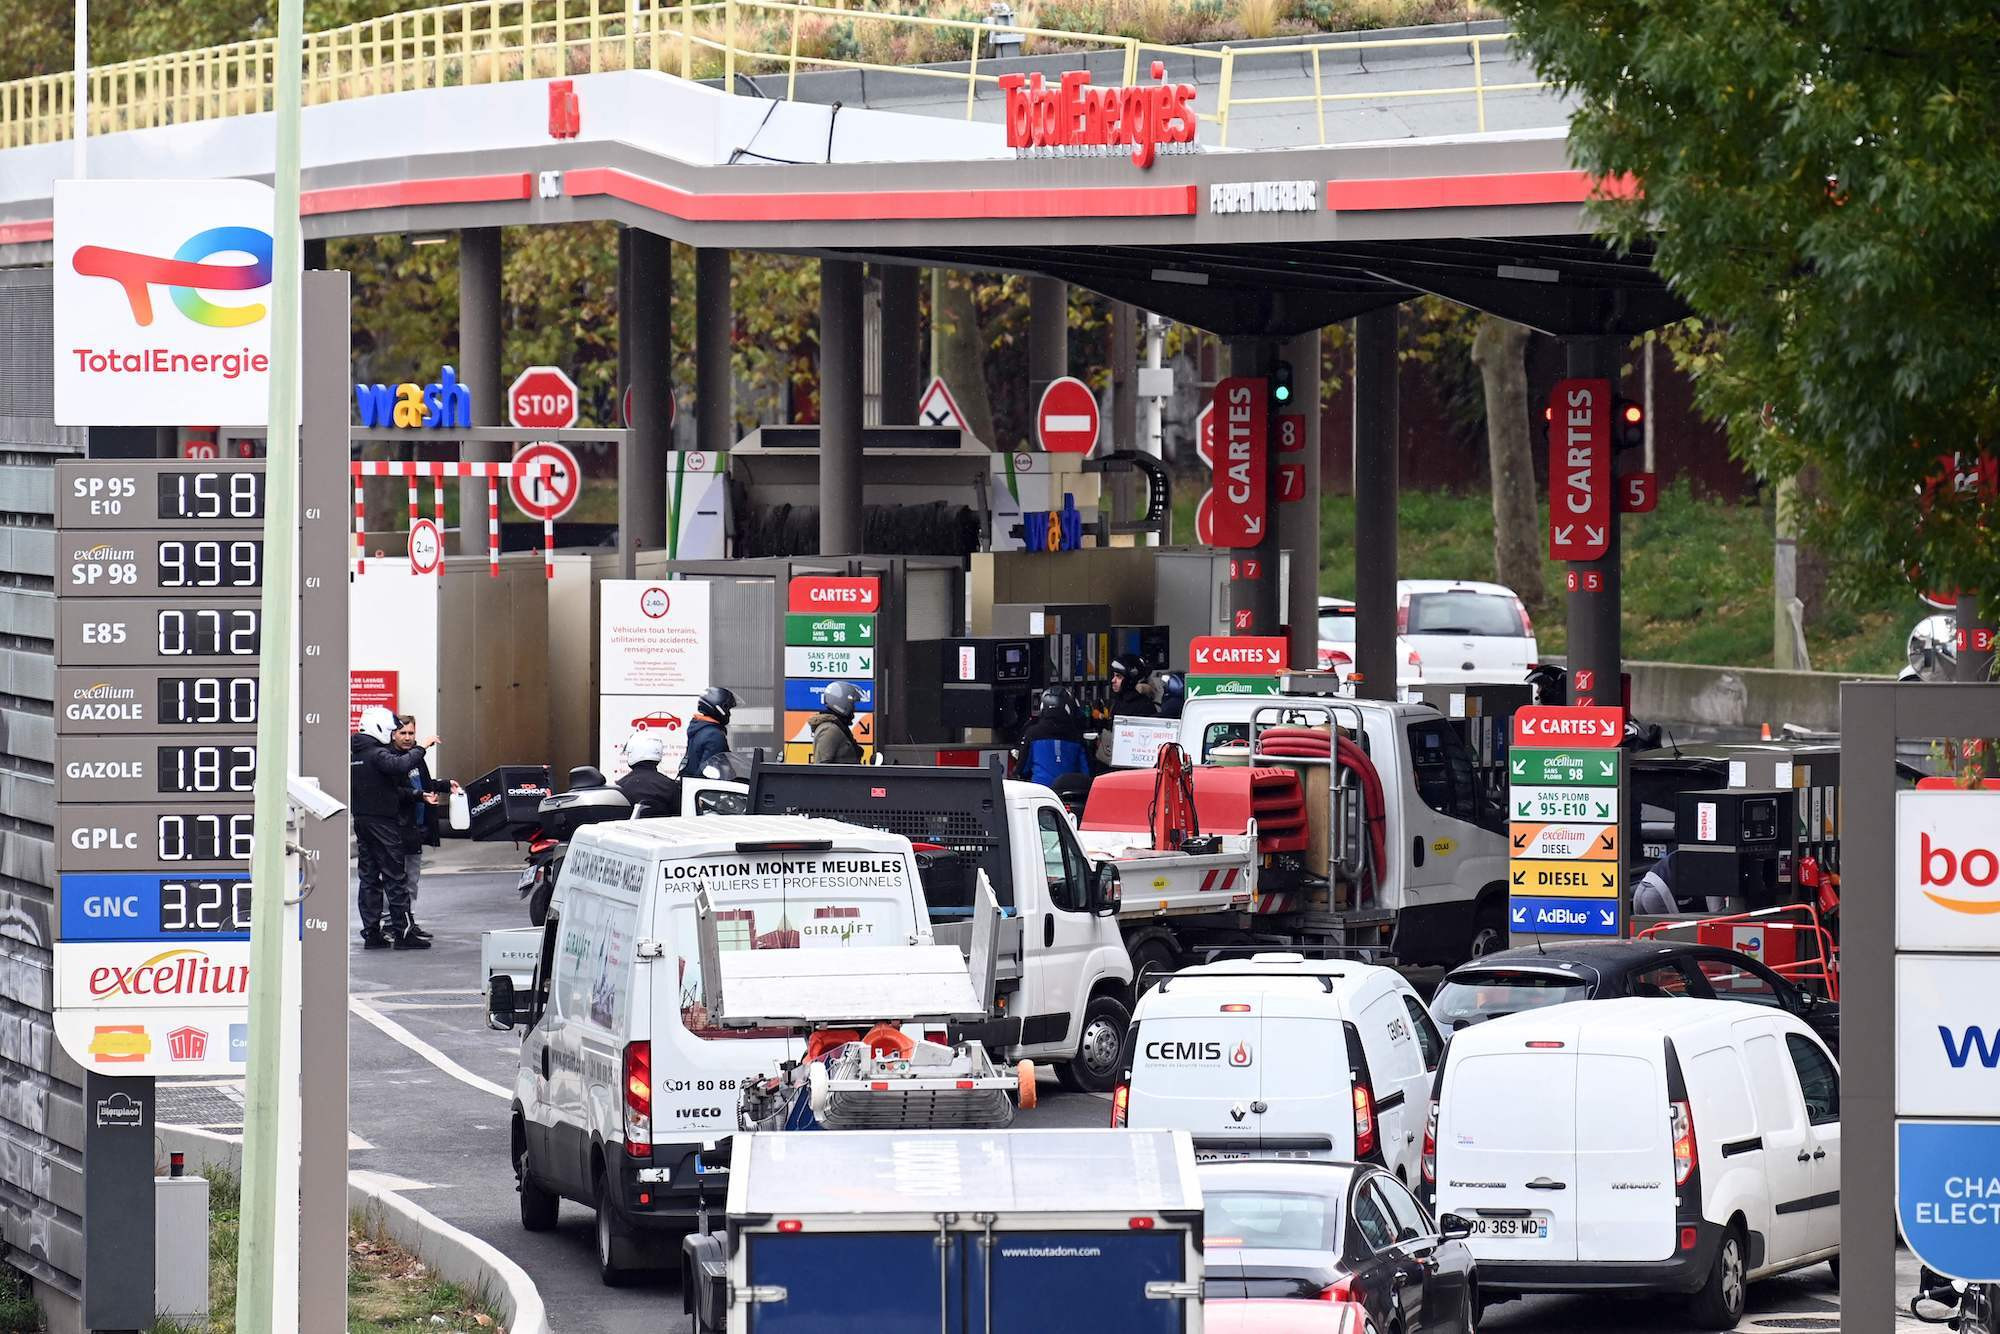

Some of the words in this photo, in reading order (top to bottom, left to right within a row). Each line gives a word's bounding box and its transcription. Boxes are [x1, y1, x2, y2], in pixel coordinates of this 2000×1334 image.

[999, 60, 1197, 169] TotalEnergies
[356, 365, 472, 428] wash
[518, 395, 569, 416] STOP
[1282, 420, 1295, 446] 8
[1228, 387, 1252, 504] CARTES
[1567, 388, 1592, 514] CARTES
[73, 478, 103, 497] SP
[107, 478, 136, 497] 95
[1282, 470, 1295, 496] 7
[177, 473, 256, 517] 1.58
[1630, 480, 1644, 506] 5
[90, 500, 121, 515] E10
[73, 544, 134, 560] excellium
[159, 542, 256, 587] 9.99
[1247, 562, 1257, 576] 7
[71, 564, 102, 585] SP
[109, 564, 138, 585] 98
[1567, 574, 1574, 589] 6
[1588, 574, 1597, 588] 5
[810, 588, 857, 602] CARTES
[82, 623, 127, 644] E85
[159, 610, 256, 655] 0.72
[812, 621, 846, 630] excellium
[833, 630, 846, 642] 98
[1978, 633, 1987, 647] 3
[807, 652, 825, 660] SANS
[828, 652, 850, 660] PLOMB
[1212, 648, 1264, 663] CARTES
[809, 661, 848, 673] 95-E10
[73, 683, 134, 699] excellium
[1216, 682, 1252, 693] excellium
[177, 678, 256, 723] 1.90
[66, 703, 143, 720] GAZOLE
[1540, 719, 1597, 734] CARTES
[1543, 755, 1584, 767] excellium
[66, 762, 143, 779] GAZOLE
[177, 747, 255, 792] 1.82
[1568, 768, 1584, 781] 98
[1538, 792, 1559, 801] SANS
[1562, 793, 1590, 802] PLOMB
[1540, 803, 1587, 816] 95-E10
[71, 828, 138, 850] GPLc
[159, 814, 254, 860] 0.76
[1542, 828, 1585, 841] excellium
[1541, 844, 1572, 855] DIESEL
[1920, 831, 1999, 887] bo
[664, 863, 750, 879] LOCATION
[756, 861, 816, 875] MONTE
[822, 860, 901, 873] MEUBLES
[763, 878, 779, 889] ET
[784, 876, 902, 889] PROFESSIONNELS
[1538, 871, 1589, 886] DIESEL
[83, 896, 139, 918] GNC
[305, 918, 328, 931] €/kg
[804, 922, 873, 937] GIRALIFT
[172, 1029, 206, 1059] UTA
[1145, 1042, 1222, 1060] CEMIS
[676, 1081, 691, 1091] 01
[697, 1080, 714, 1091] 80
[719, 1080, 736, 1090] 88
[676, 1107, 722, 1118] IVECO
[1945, 1176, 2000, 1198] CHA
[1916, 1202, 2000, 1225] ELECT
[1001, 1245, 1101, 1257] www.toutadom.com
